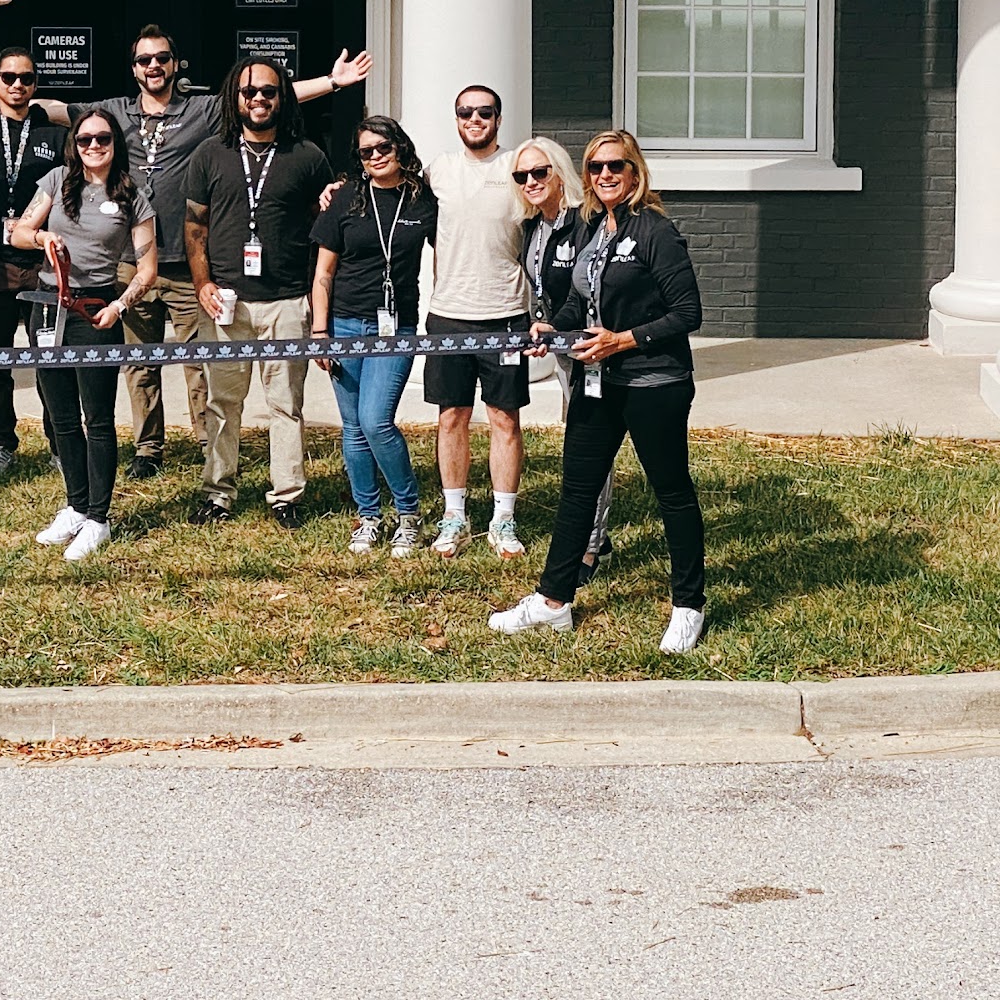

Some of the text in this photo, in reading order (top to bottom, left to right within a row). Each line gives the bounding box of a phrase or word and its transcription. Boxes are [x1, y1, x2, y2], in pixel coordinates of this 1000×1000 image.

[38, 35, 86, 46] CAMERAS
[45, 50, 78, 60] IN USE
